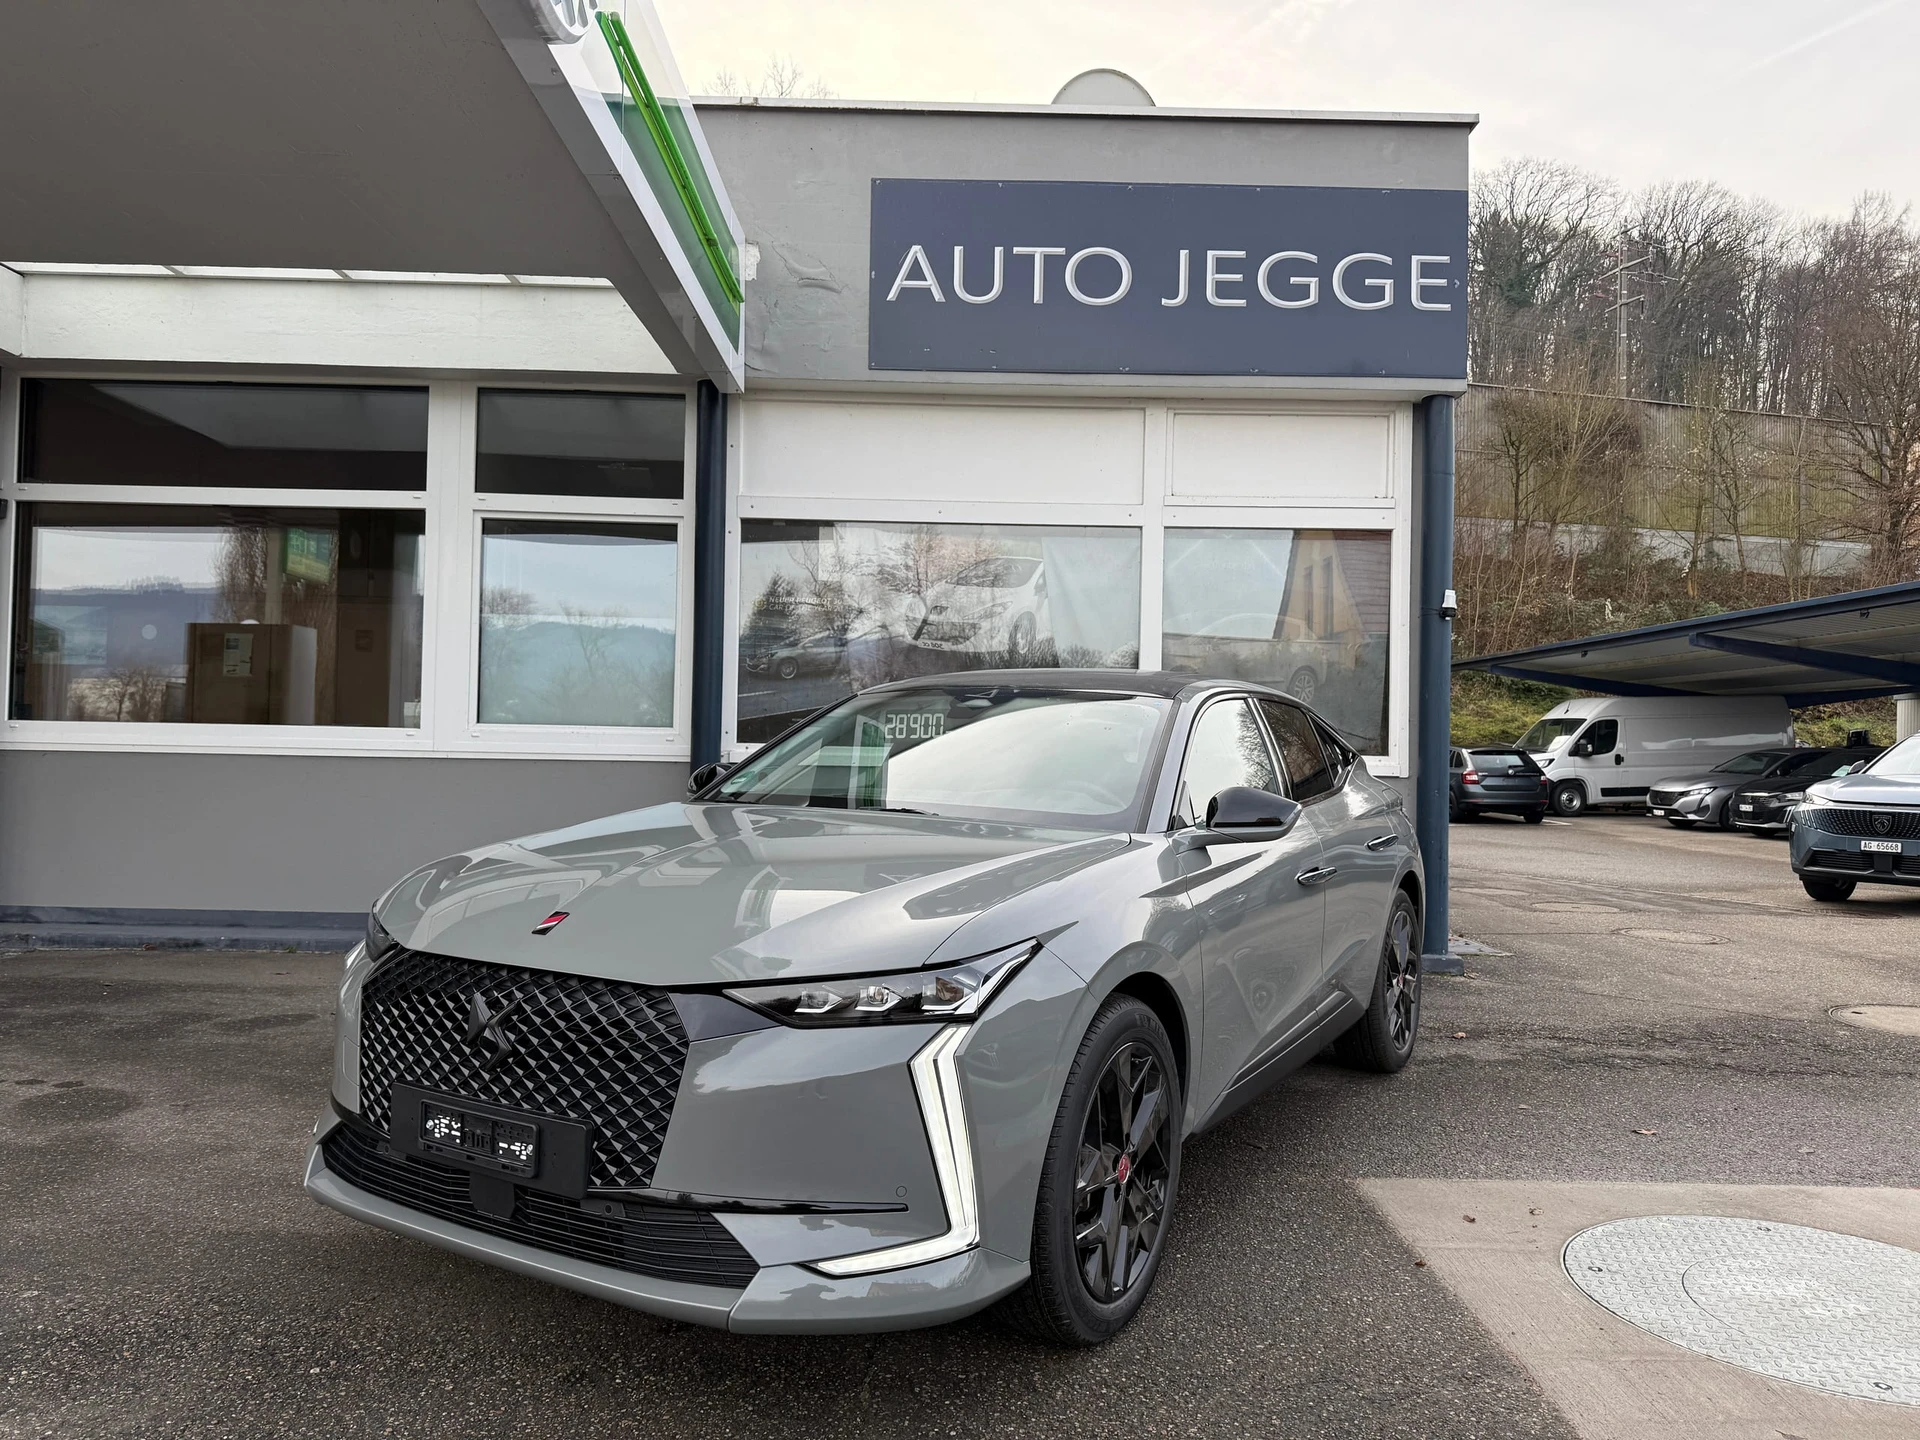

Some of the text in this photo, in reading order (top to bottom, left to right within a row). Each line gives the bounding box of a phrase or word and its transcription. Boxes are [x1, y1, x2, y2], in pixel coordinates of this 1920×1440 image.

[887, 245, 1452, 311] AUTO JEGGE
[1876, 842, 1899, 851] 65668
